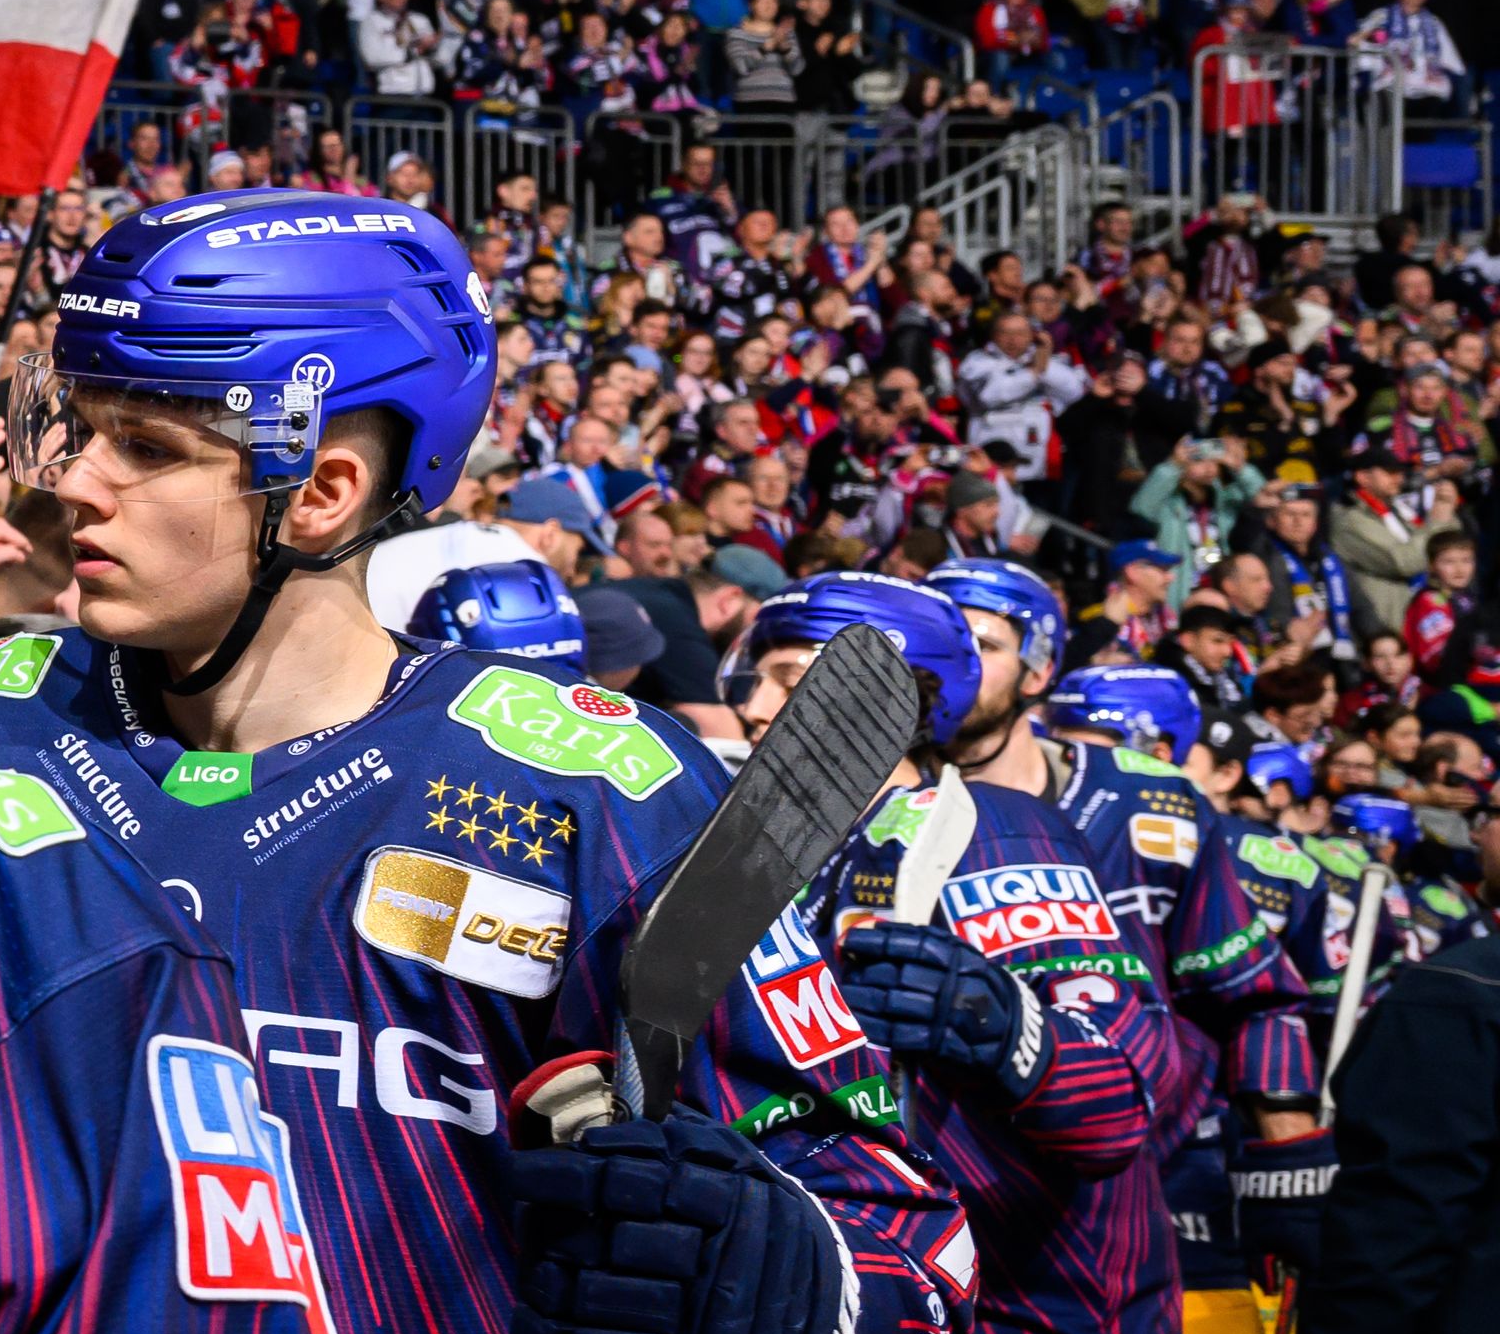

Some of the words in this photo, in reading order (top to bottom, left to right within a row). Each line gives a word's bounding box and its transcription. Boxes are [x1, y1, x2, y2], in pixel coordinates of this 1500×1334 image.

[206, 212, 417, 250] STADLER
[497, 638, 584, 658] TADLER
[470, 679, 651, 785] Karls
[525, 739, 565, 762] 1921
[53, 732, 142, 841] structure
[178, 766, 240, 785] LIGO
[241, 746, 386, 851] structure
[376, 886, 456, 921] PENNY
[947, 868, 1093, 918] LIQUI
[965, 900, 1102, 954] MOLY
